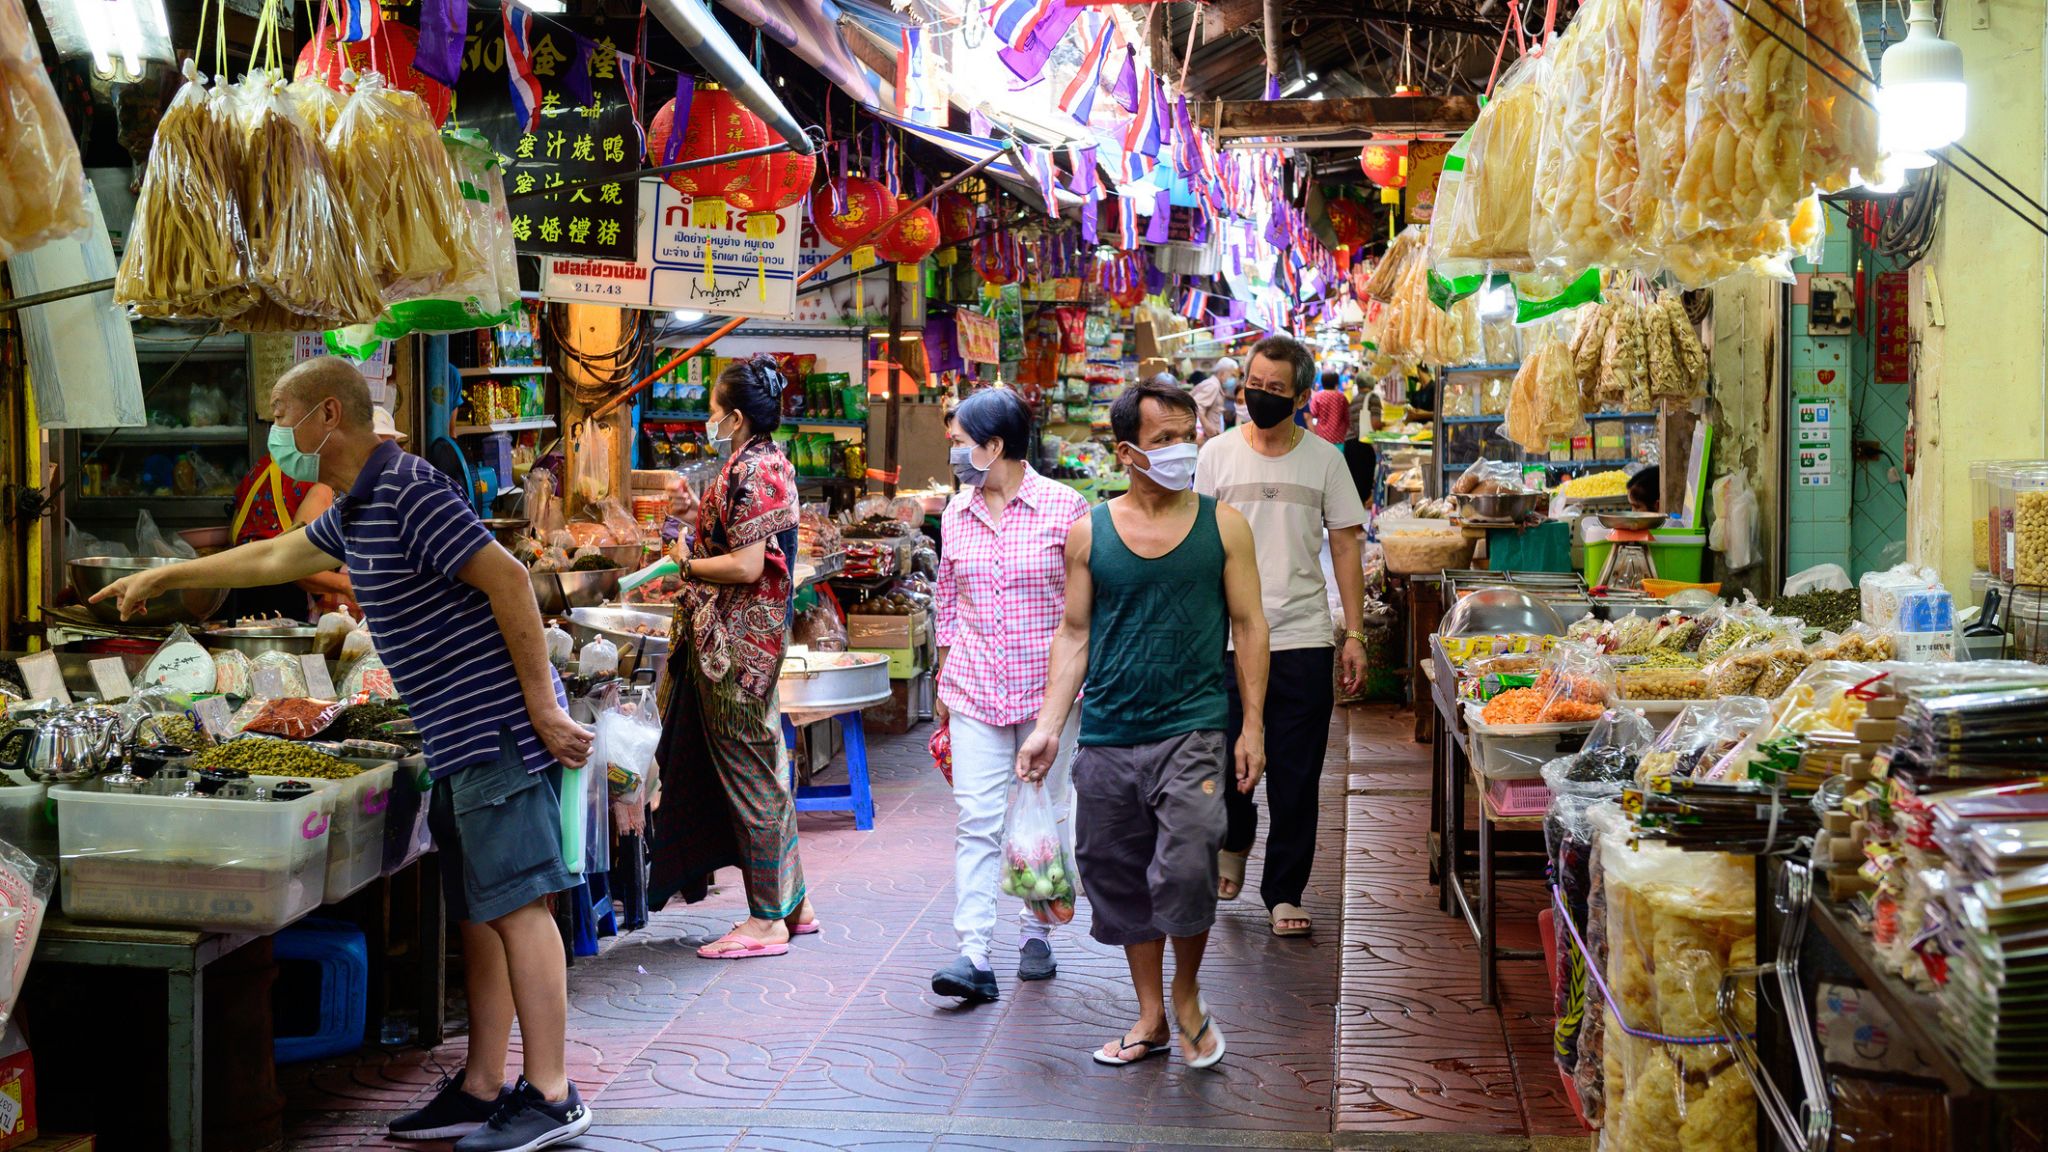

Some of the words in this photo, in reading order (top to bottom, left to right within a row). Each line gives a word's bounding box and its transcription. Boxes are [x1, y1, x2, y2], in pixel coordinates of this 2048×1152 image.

[515, 130, 625, 162] 蜜汁燒鴨
[711, 234, 740, 249] หมูย่าง
[662, 245, 689, 257] บะจ่าง
[693, 245, 738, 262] น้ำริกเผา
[553, 259, 648, 281] เชลล์ชวนชิม
[575, 282, 622, 294] 21.7.43
[302, 336, 310, 346] 12
[301, 348, 310, 358] 19
